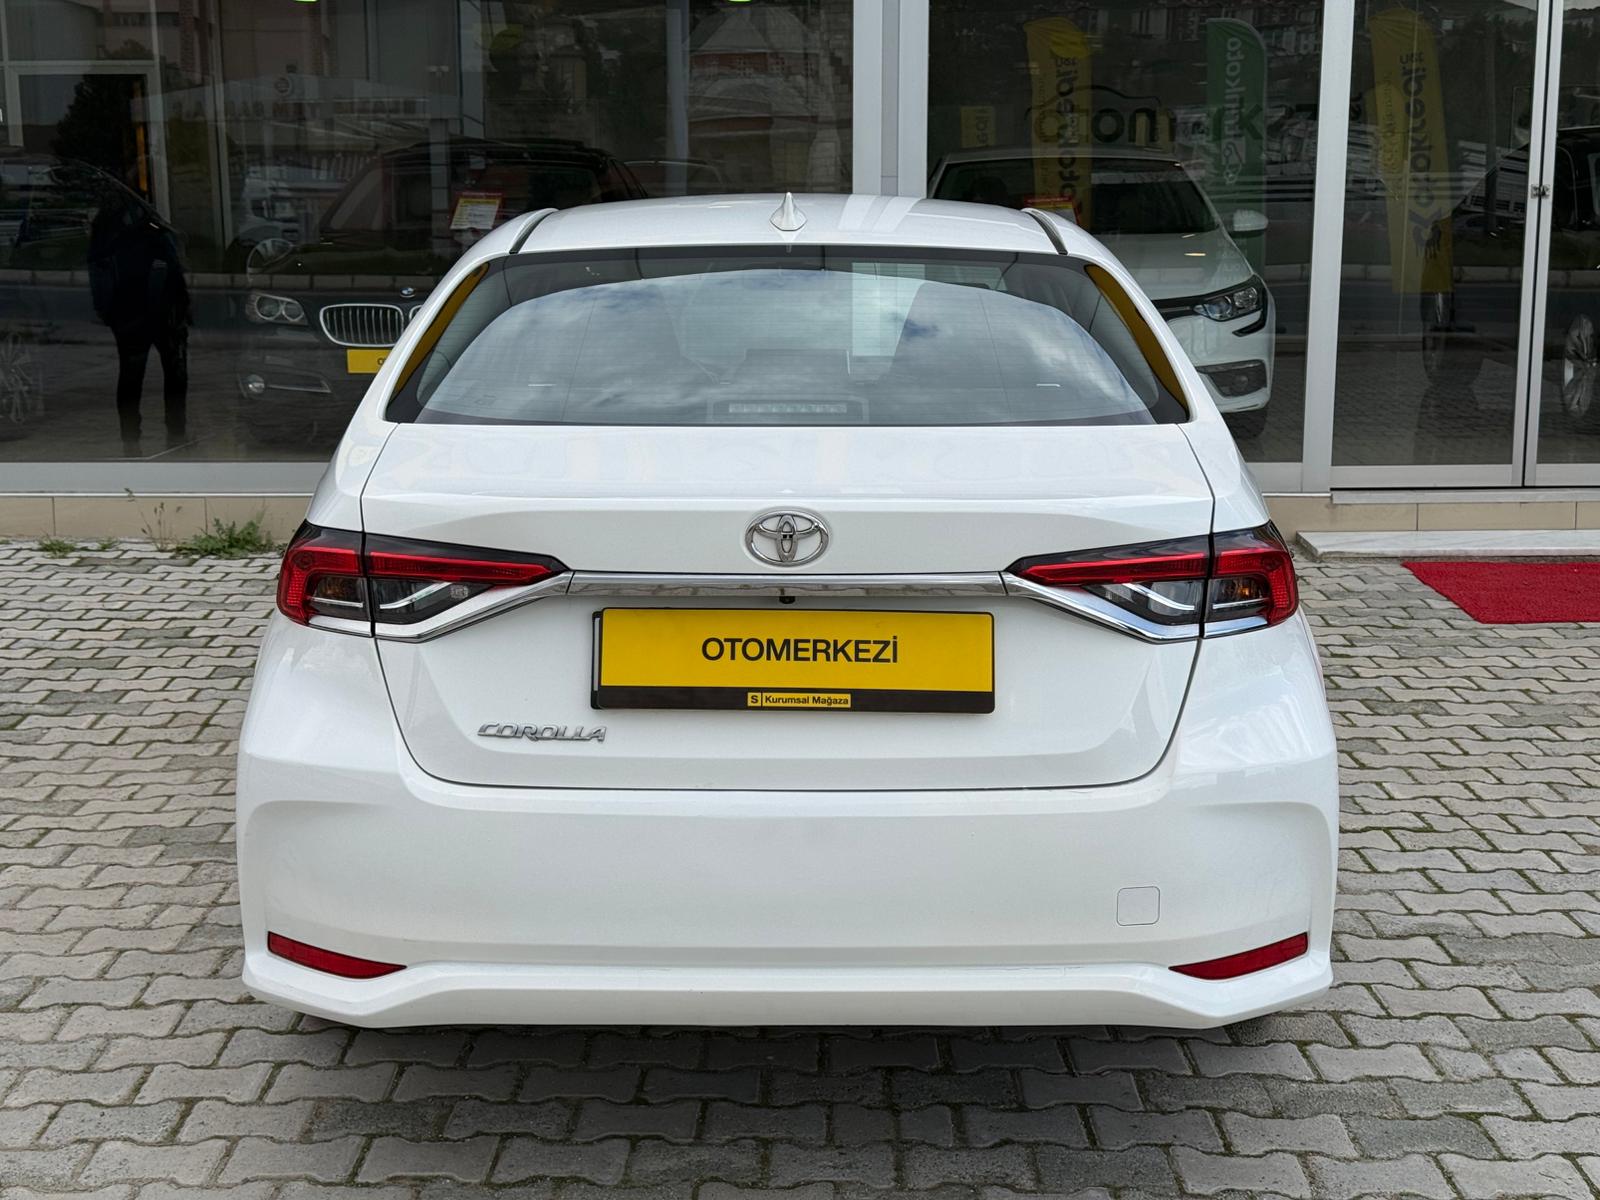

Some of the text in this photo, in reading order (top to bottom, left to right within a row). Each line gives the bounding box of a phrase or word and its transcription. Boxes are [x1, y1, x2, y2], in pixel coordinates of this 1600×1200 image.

[701, 635, 898, 663] OTOMERKEZİ
[765, 695, 810, 705] Kurumsal
[812, 696, 849, 706] Mağaza
[477, 722, 607, 742] COROLLA
